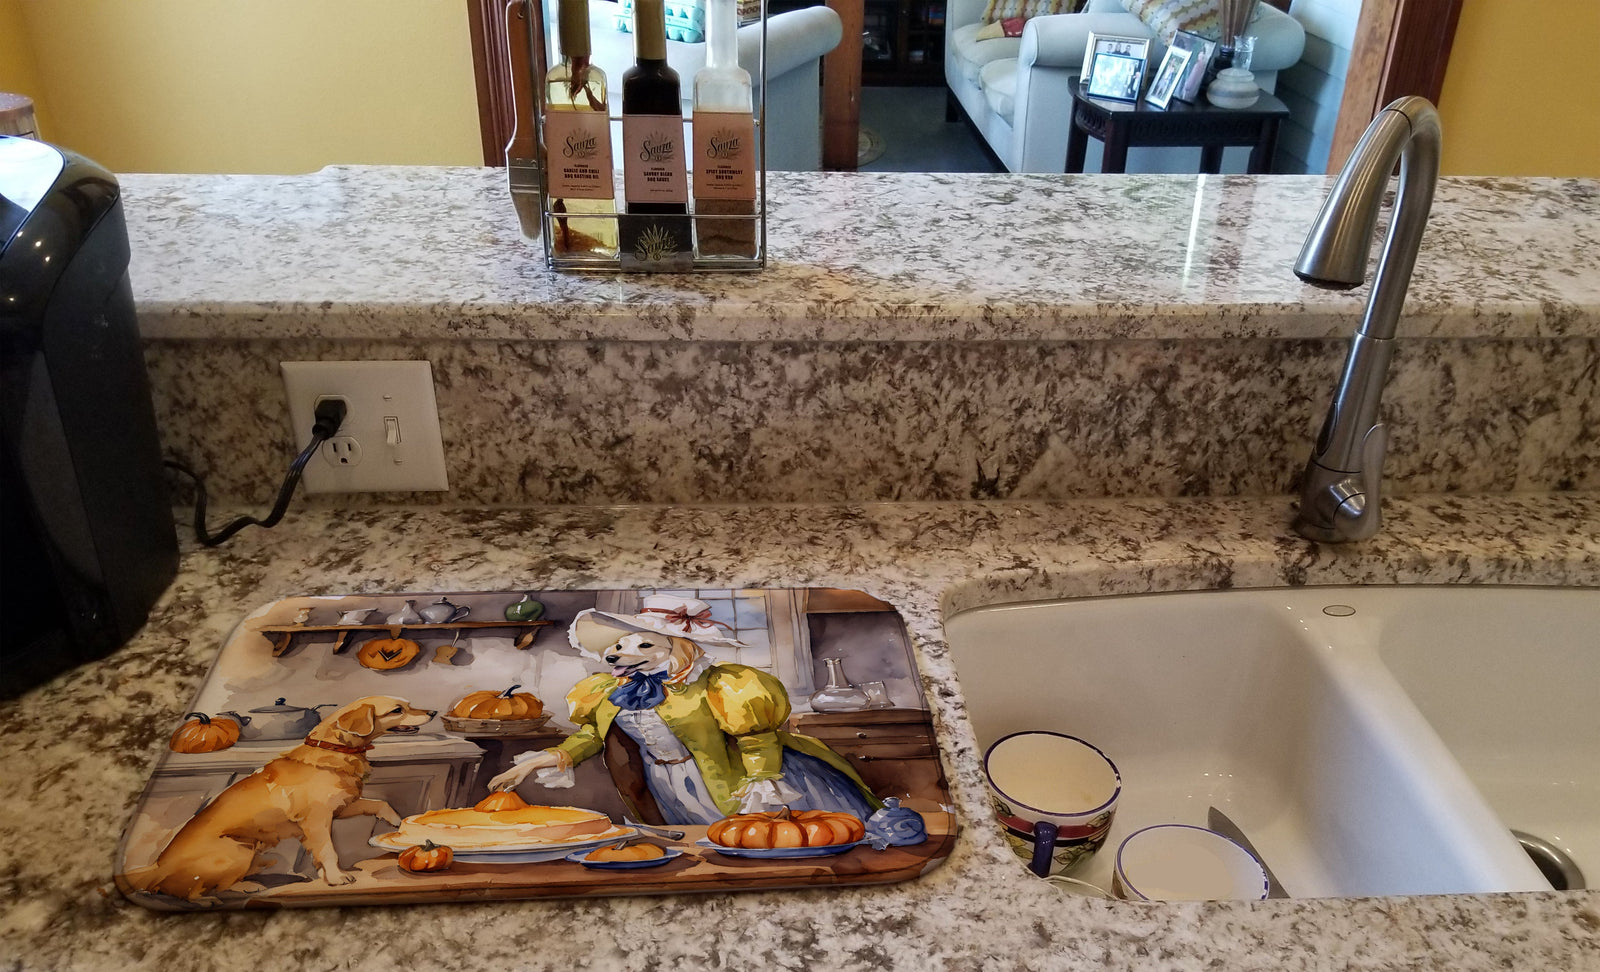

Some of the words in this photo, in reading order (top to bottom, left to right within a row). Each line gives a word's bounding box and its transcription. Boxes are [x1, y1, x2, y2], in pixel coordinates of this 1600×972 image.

[562, 136, 597, 158] Sauza
[640, 140, 673, 162] Sauza
[706, 136, 739, 159] Sauza
